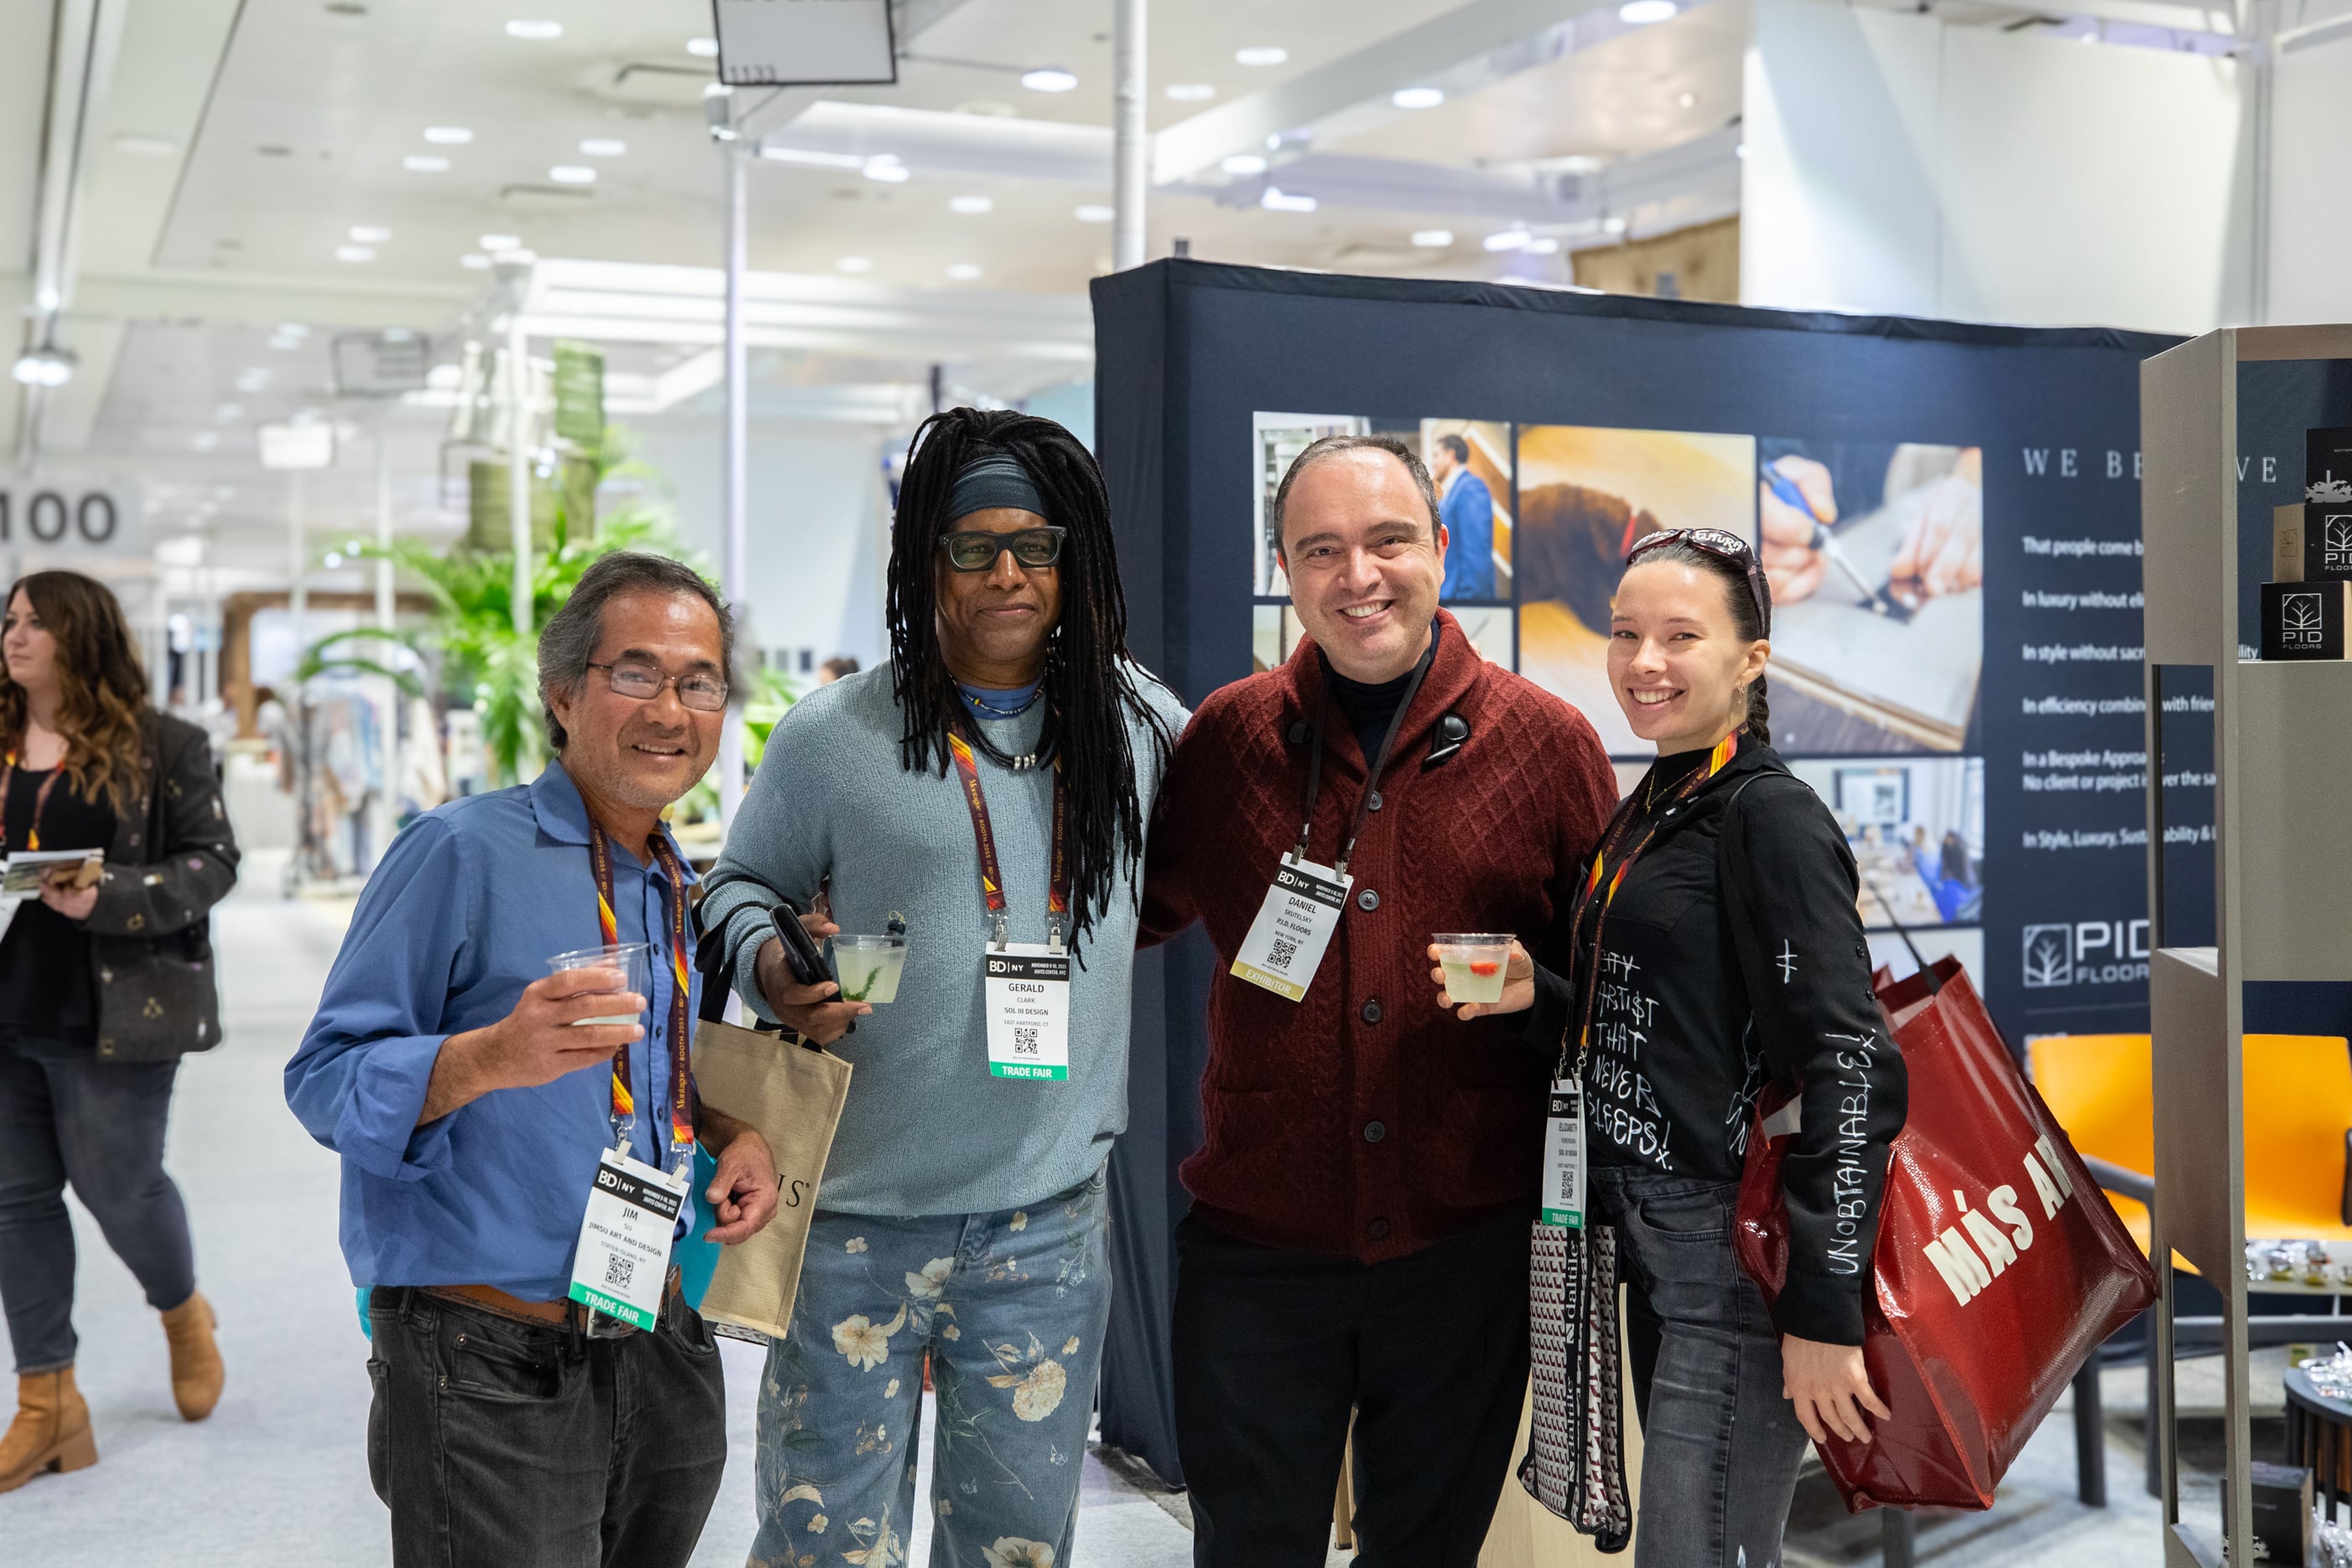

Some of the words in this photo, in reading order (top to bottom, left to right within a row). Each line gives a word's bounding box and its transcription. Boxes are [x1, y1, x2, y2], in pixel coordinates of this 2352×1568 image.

[2023, 449, 2078, 477] WE
[2022, 536, 2051, 554] That
[2053, 538, 2097, 557] people
[2098, 541, 2132, 555] come
[2325, 553, 2352, 564] PI
[2022, 591, 2036, 607] In
[2038, 591, 2077, 611] luxury
[2079, 591, 2127, 607] without
[2282, 631, 2323, 642] PID
[2022, 645, 2036, 660] In
[2039, 643, 2067, 664] style
[2069, 644, 2118, 661] without
[2022, 698, 2036, 713] In
[2038, 695, 2097, 717] efficiency
[2162, 695, 2189, 712] with
[2022, 751, 2036, 767] In
[2049, 749, 2101, 770] Bespoke
[2022, 774, 2042, 791] No
[2044, 773, 2078, 791] client
[2096, 773, 2139, 792] project
[2180, 770, 2201, 787] the
[968, 779, 982, 811] Montague
[2022, 832, 2037, 848] In
[1297, 880, 1310, 890] NY
[1288, 896, 1317, 914] DANIEL
[1284, 909, 1313, 924] SKUTELSKY
[1290, 923, 1312, 936] FLOORS
[1246, 968, 1292, 995] EXHIBITOR
[2076, 963, 2150, 983] FLOOR
[1008, 983, 1044, 993] GERALD
[1596, 1022, 1648, 1060] THAT
[1002, 1065, 1030, 1077] TRADE
[1033, 1067, 1053, 1078] FAIR
[677, 1071, 688, 1109] Montague
[1591, 1055, 1662, 1118] NEVER
[622, 1182, 636, 1194] NY
[622, 1206, 638, 1220] JIM
[1552, 1212, 1568, 1223] TRADE
[1569, 1215, 1579, 1225] FAIR
[624, 1223, 632, 1231] SU
[589, 1221, 608, 1236] JIMSU
[609, 1229, 622, 1240] ART
[623, 1235, 637, 1247] AND
[638, 1241, 663, 1257] DESIGN
[601, 1240, 619, 1253] STATEN
[1922, 1184, 2034, 1307] MÁS
[1565, 1243, 1578, 1319] daltile
[585, 1291, 616, 1313] TRADE
[617, 1305, 640, 1323] FAIR
[1566, 1380, 1575, 1457] daltile
